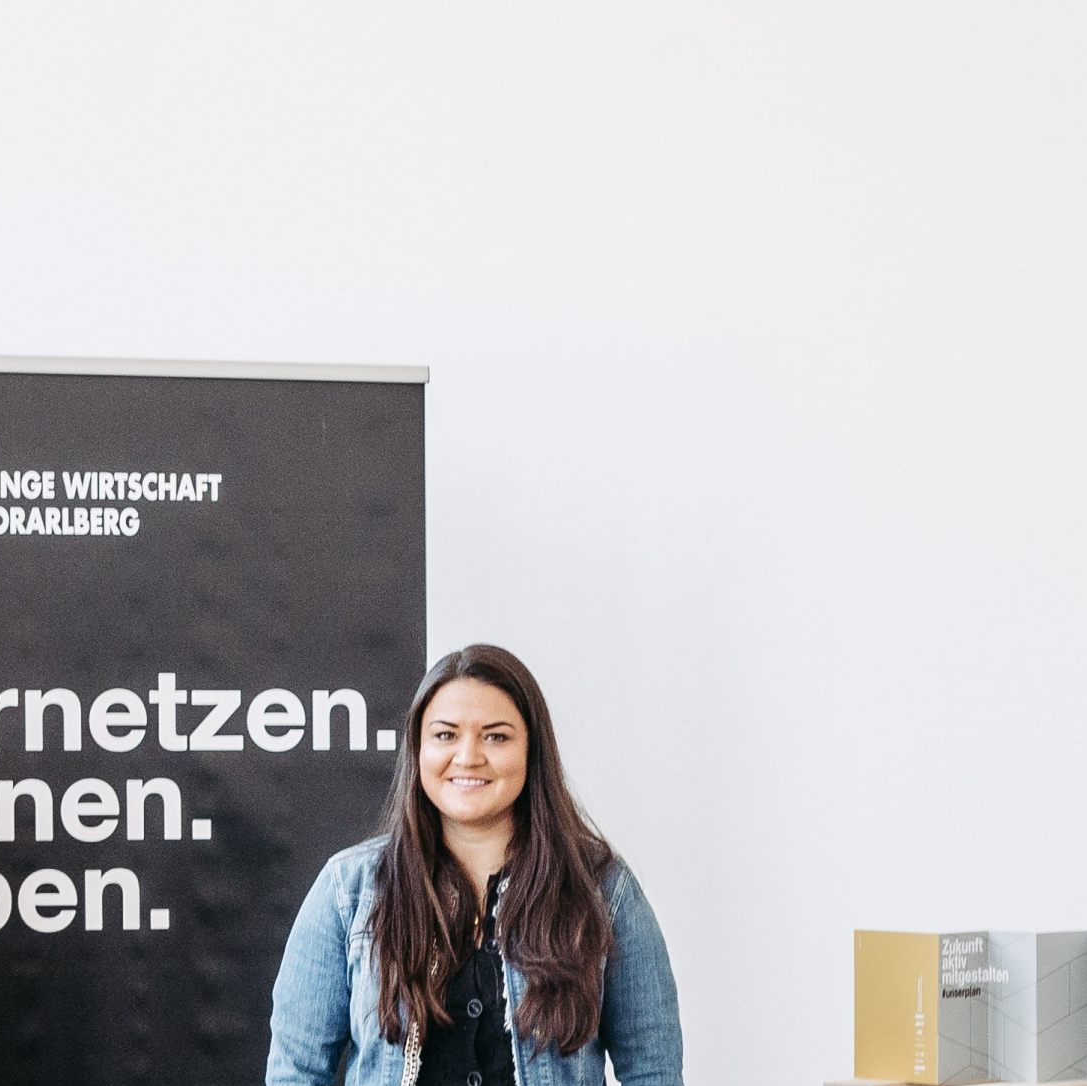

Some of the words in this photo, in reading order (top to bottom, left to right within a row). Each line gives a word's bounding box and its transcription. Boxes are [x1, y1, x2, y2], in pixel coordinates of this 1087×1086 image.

[62, 470, 223, 502] WIRTSCHAFT
[942, 937, 984, 955] Zukunft
[942, 954, 967, 969] aktiv
[942, 966, 1008, 986] mitgestalten
